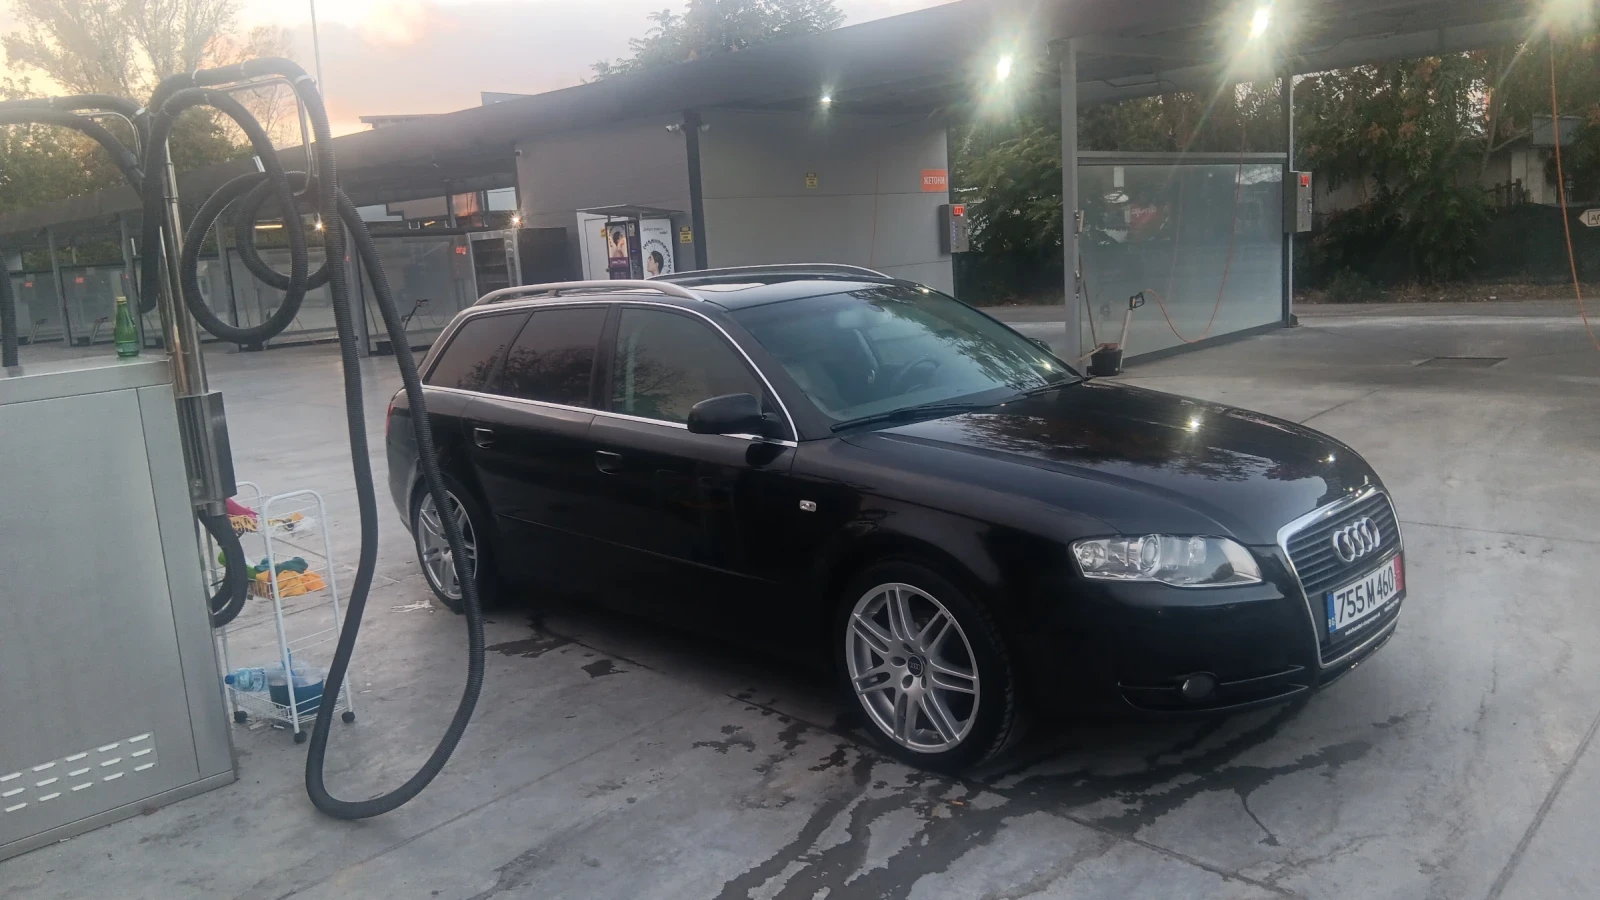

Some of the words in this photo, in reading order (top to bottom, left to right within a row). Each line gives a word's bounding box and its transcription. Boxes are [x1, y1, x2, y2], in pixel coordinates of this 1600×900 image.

[1337, 585, 1365, 623] 755
[1366, 578, 1375, 608] M
[1377, 566, 1394, 599] 460
